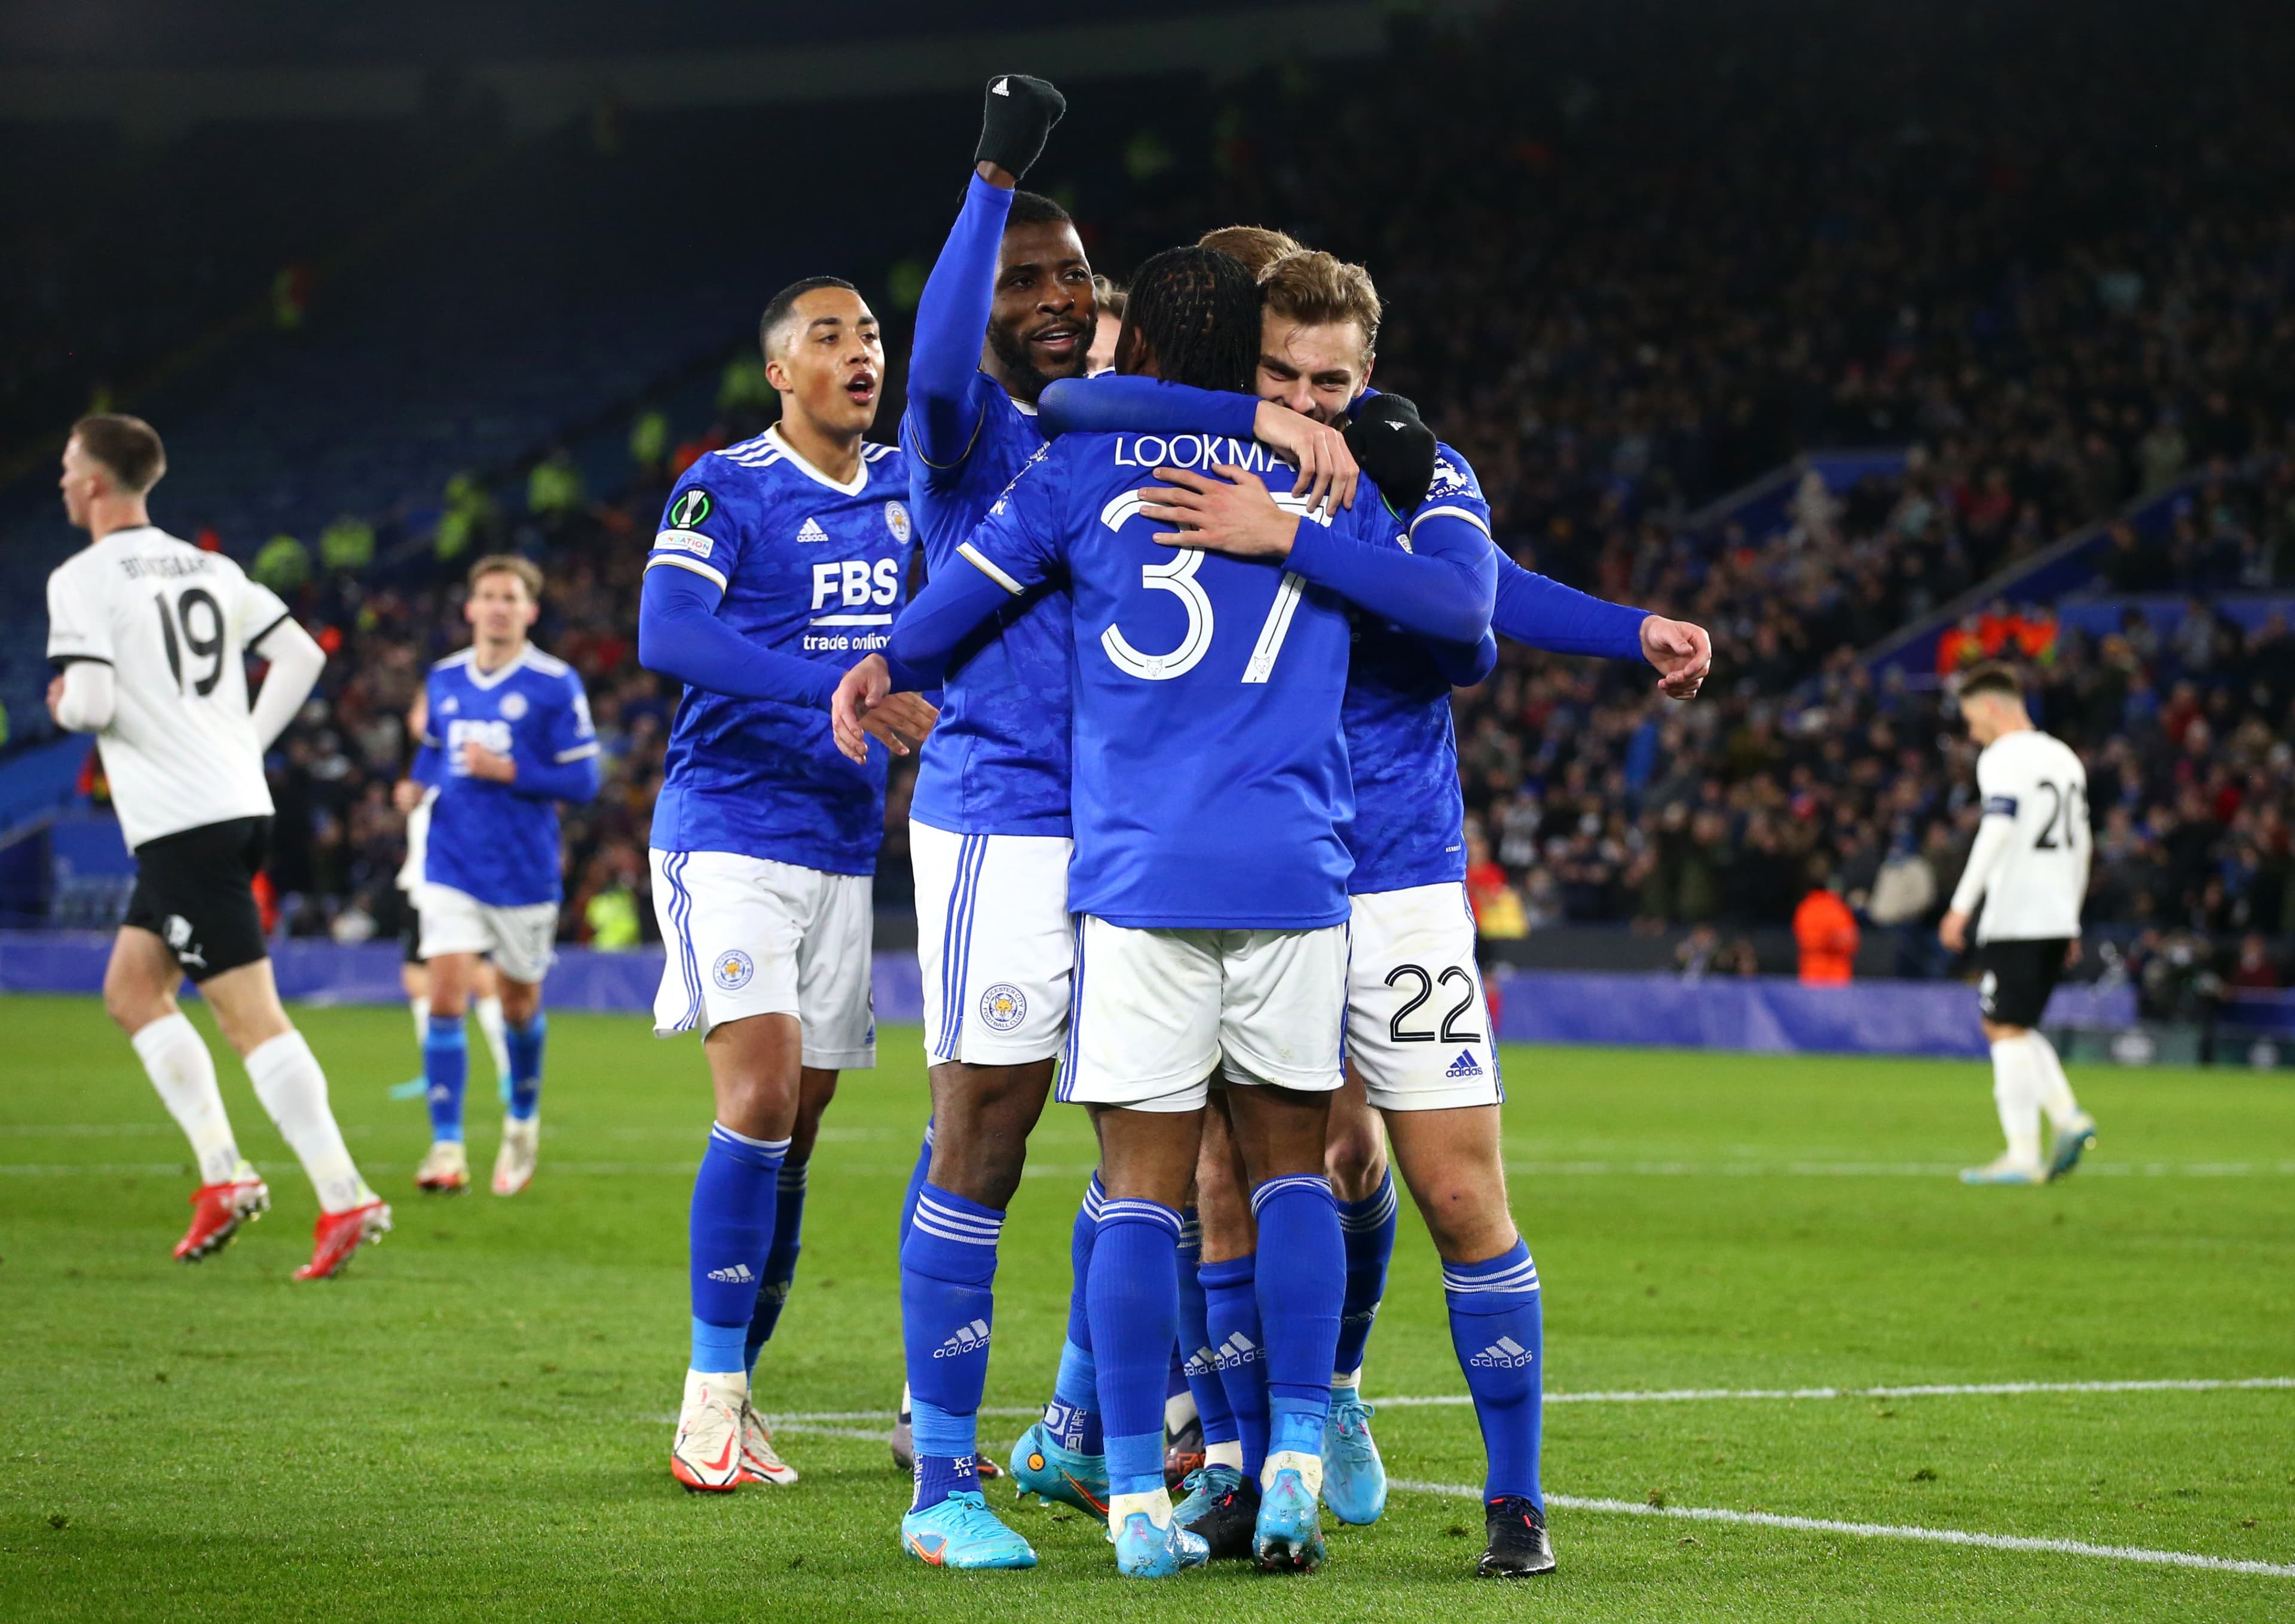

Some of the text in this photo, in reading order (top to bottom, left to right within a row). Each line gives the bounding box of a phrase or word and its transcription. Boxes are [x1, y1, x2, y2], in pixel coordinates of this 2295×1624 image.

[811, 558, 898, 610] FBS
[1100, 489, 1333, 683] 37
[154, 588, 225, 698] 19
[803, 632, 891, 650] trade onlin
[984, 987, 1024, 1008] LEICESTER CITY
[1384, 964, 1481, 1043] 22
[983, 1007, 1023, 1027] FOOTBALL CLUB
[1445, 1066, 1483, 1078] adidas
[707, 1273, 755, 1283] adidas
[933, 1334, 991, 1358] adidas
[1470, 1350, 1532, 1368] adidas
[1069, 1406, 1087, 1433] TAPE
[953, 1455, 973, 1469] KI
[957, 1468, 971, 1477] 14
